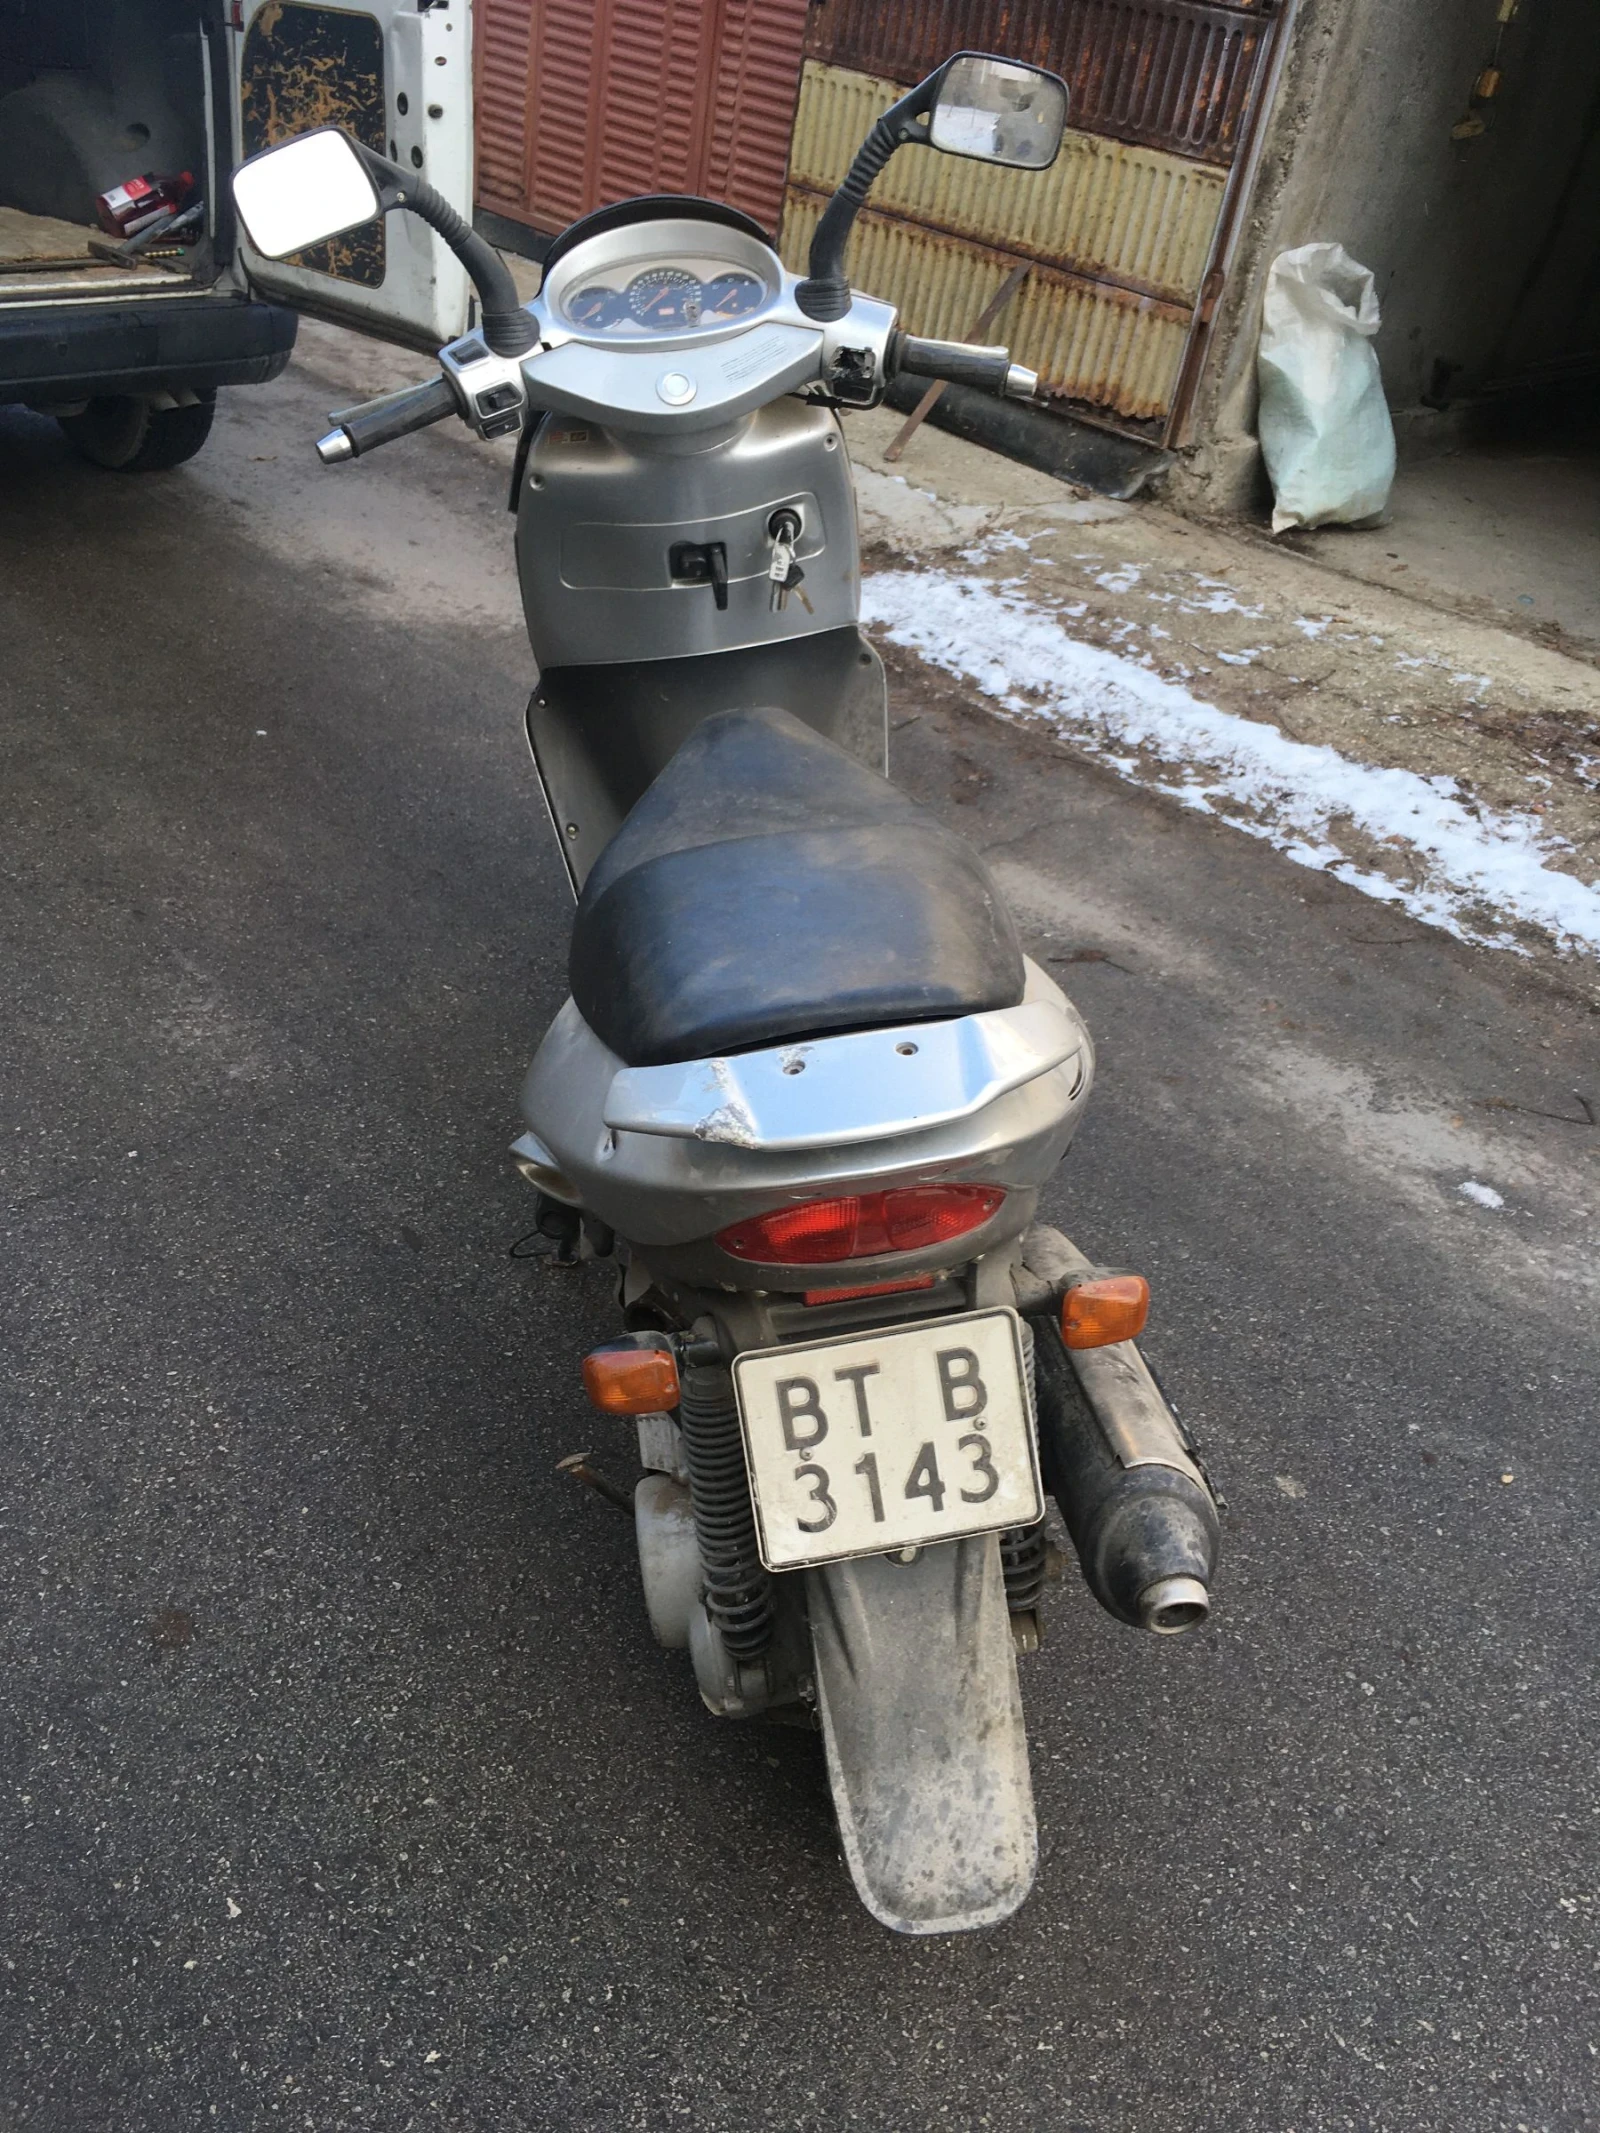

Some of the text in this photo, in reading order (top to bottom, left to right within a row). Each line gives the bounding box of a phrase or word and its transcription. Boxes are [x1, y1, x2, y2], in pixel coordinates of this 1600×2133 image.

[775, 1347, 988, 1451] BT B
[794, 1433, 999, 1533] 3143
